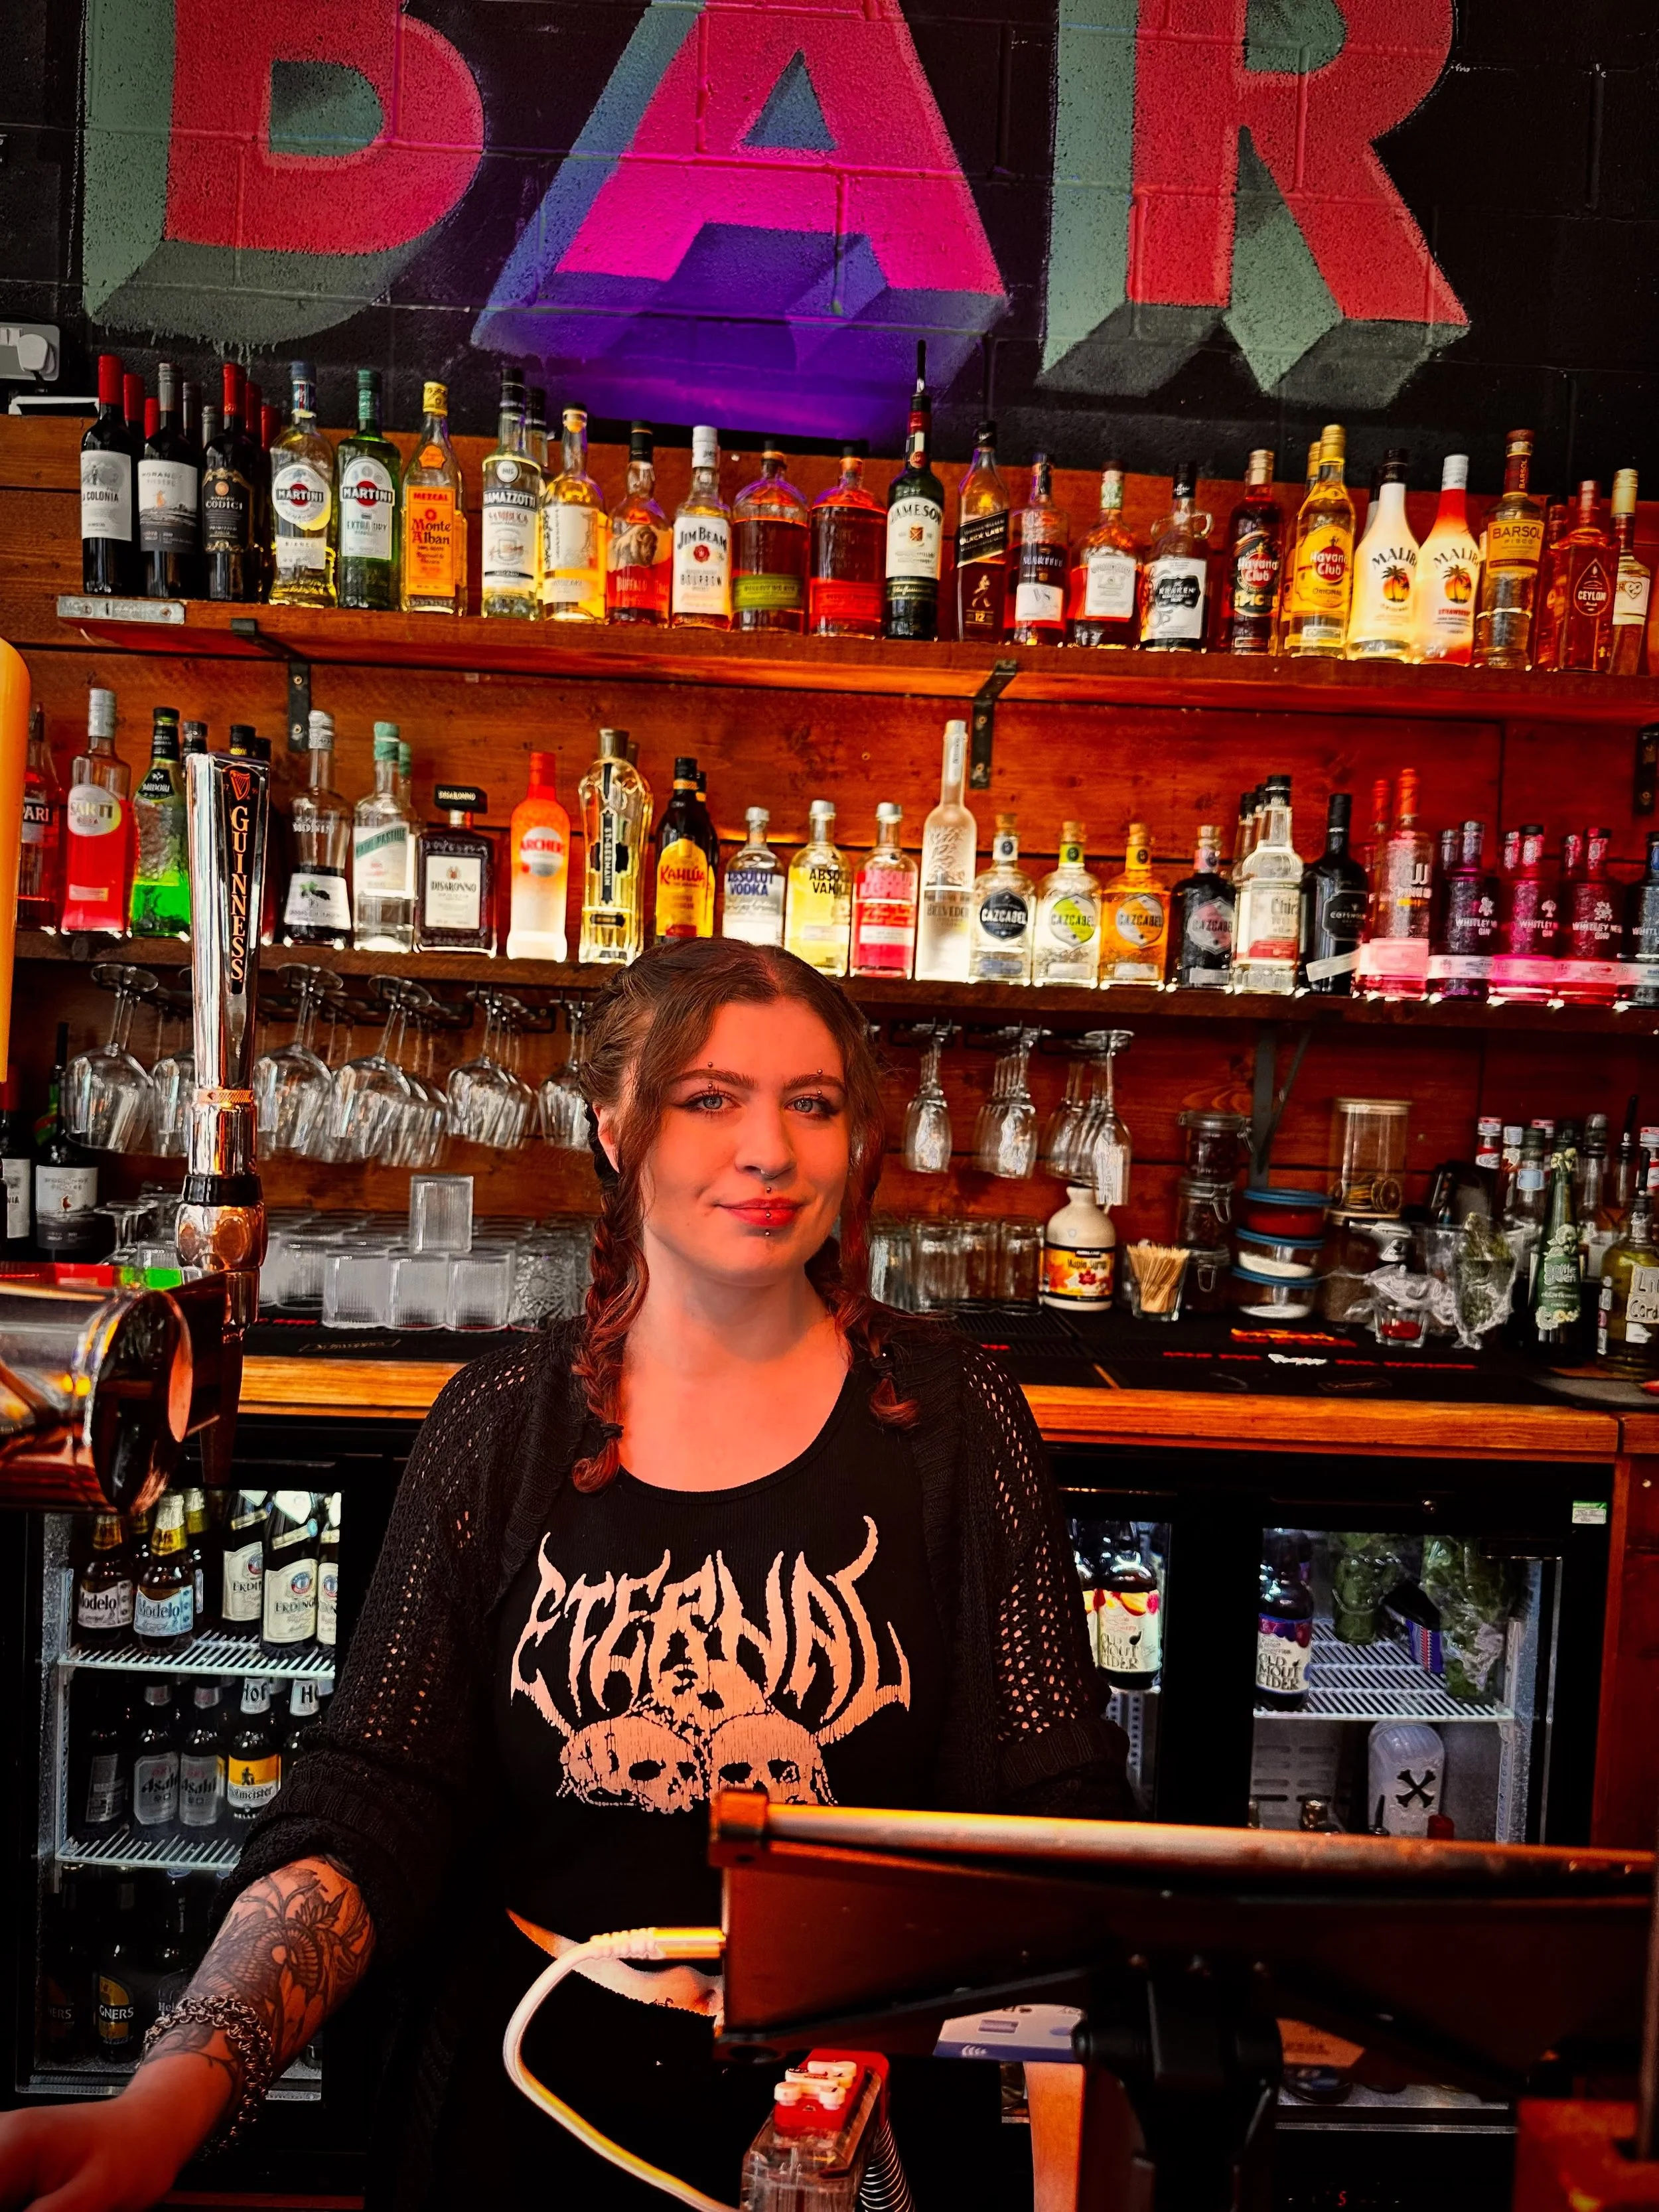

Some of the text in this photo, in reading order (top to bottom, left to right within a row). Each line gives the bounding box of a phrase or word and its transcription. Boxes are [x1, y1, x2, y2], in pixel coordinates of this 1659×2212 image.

[87, 491, 119, 502] COLONIA
[276, 488, 323, 502] MARTINI
[342, 486, 393, 503] MARTINI
[414, 492, 449, 502] MEZCAL
[484, 491, 536, 508] RAMAZZOTTI
[205, 500, 243, 510] CODICI
[890, 504, 942, 525] JAMESON
[411, 518, 451, 532] Monte
[411, 531, 450, 548] Alban
[678, 530, 696, 550] JIM
[960, 532, 983, 546] BLACK
[1493, 526, 1541, 540] BARSOL
[1237, 557, 1279, 571] Havana
[1372, 546, 1417, 570] MALIB
[1433, 548, 1480, 569] MALIB
[1246, 567, 1271, 583] Club
[1317, 563, 1341, 577] Club
[1159, 587, 1196, 595] KRAKEN
[1578, 590, 1607, 601] CEYLON
[727, 871, 774, 885] ABSOLUT
[230, 804, 250, 981] GUINNESS
[431, 880, 476, 893] DISARONNO
[730, 883, 769, 897] VODKA
[981, 908, 1028, 925] CAZCABEL
[138, 1600, 180, 1619] Modelo
[1100, 1655, 1139, 1670] CIDER
[1258, 1653, 1286, 1666] OLD
[1259, 1664, 1301, 1678] MOUT
[1256, 1673, 1299, 1690] CIDER
